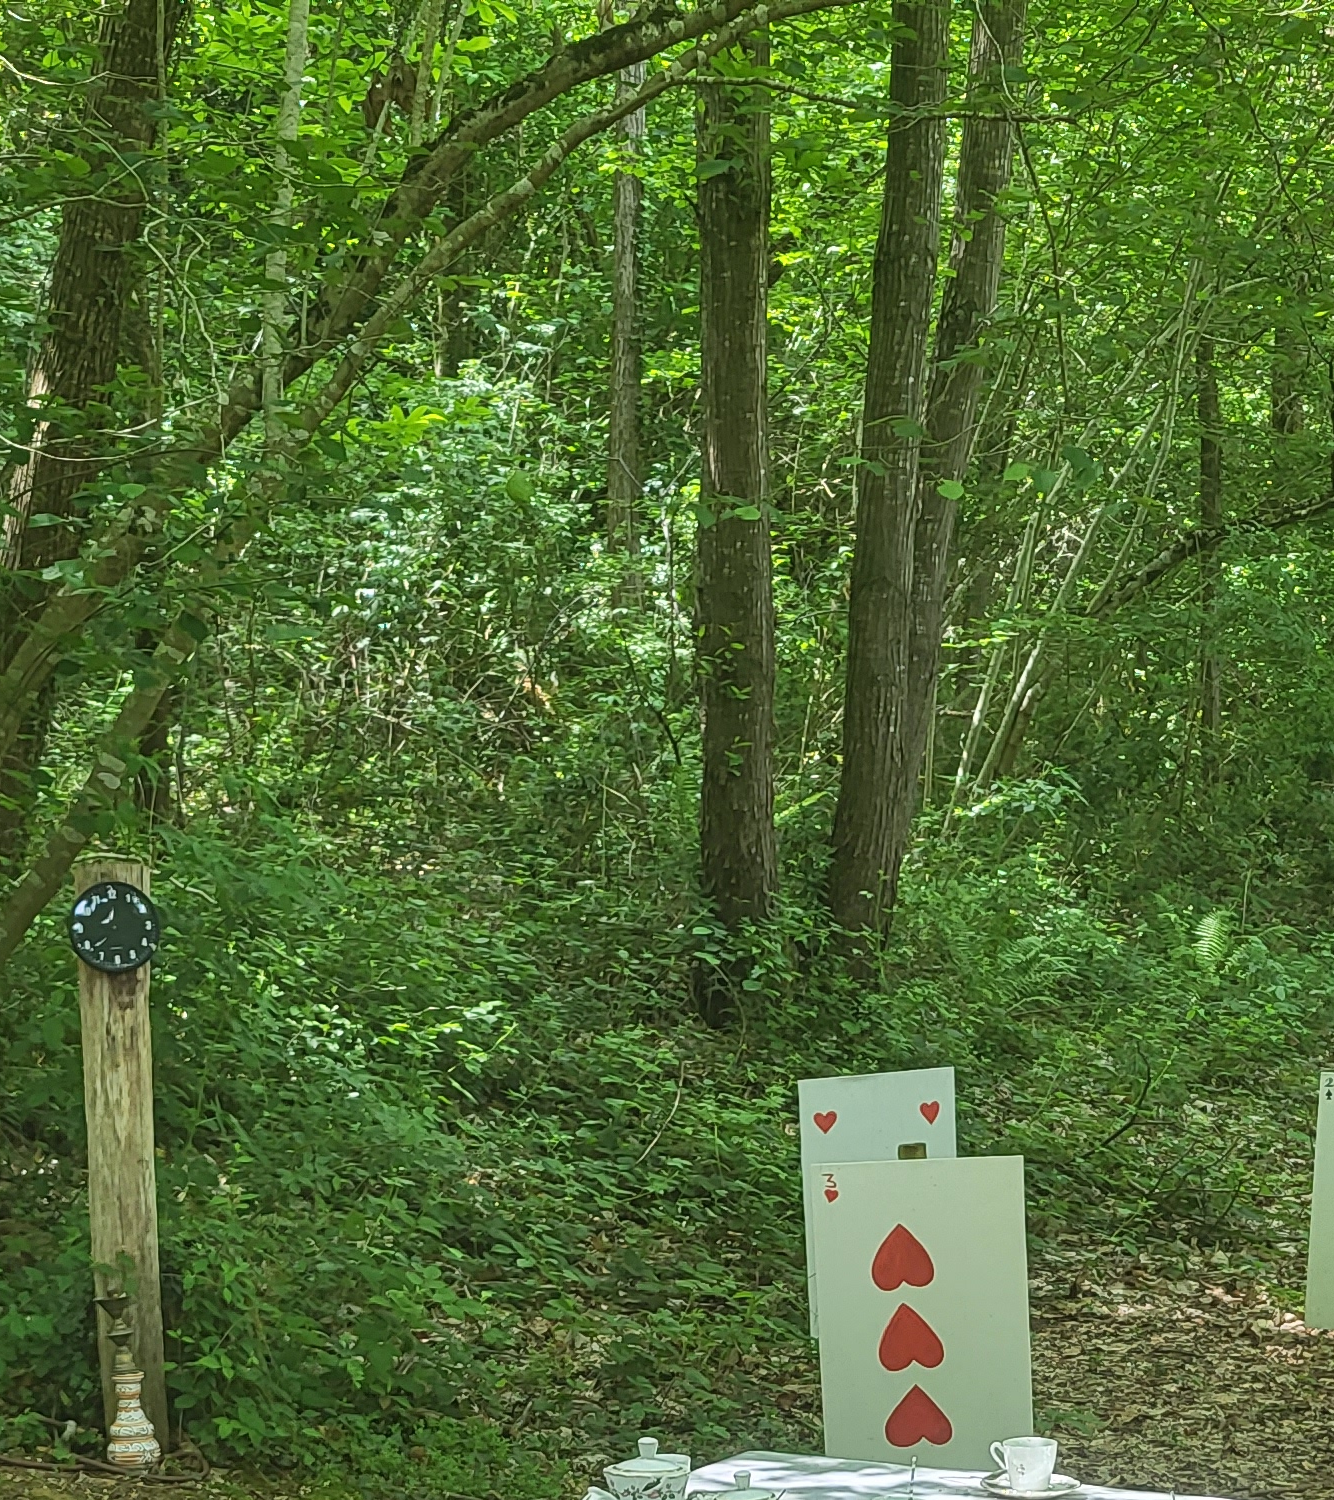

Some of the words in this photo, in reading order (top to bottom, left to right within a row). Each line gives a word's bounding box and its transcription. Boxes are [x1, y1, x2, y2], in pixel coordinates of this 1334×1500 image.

[107, 889, 117, 899] 12
[125, 893, 131, 903] 1
[145, 920, 152, 930] 3
[141, 937, 148, 947] 4
[98, 951, 104, 961] 7
[1324, 1077, 1334, 1087] 2
[821, 1173, 837, 1188] 3
